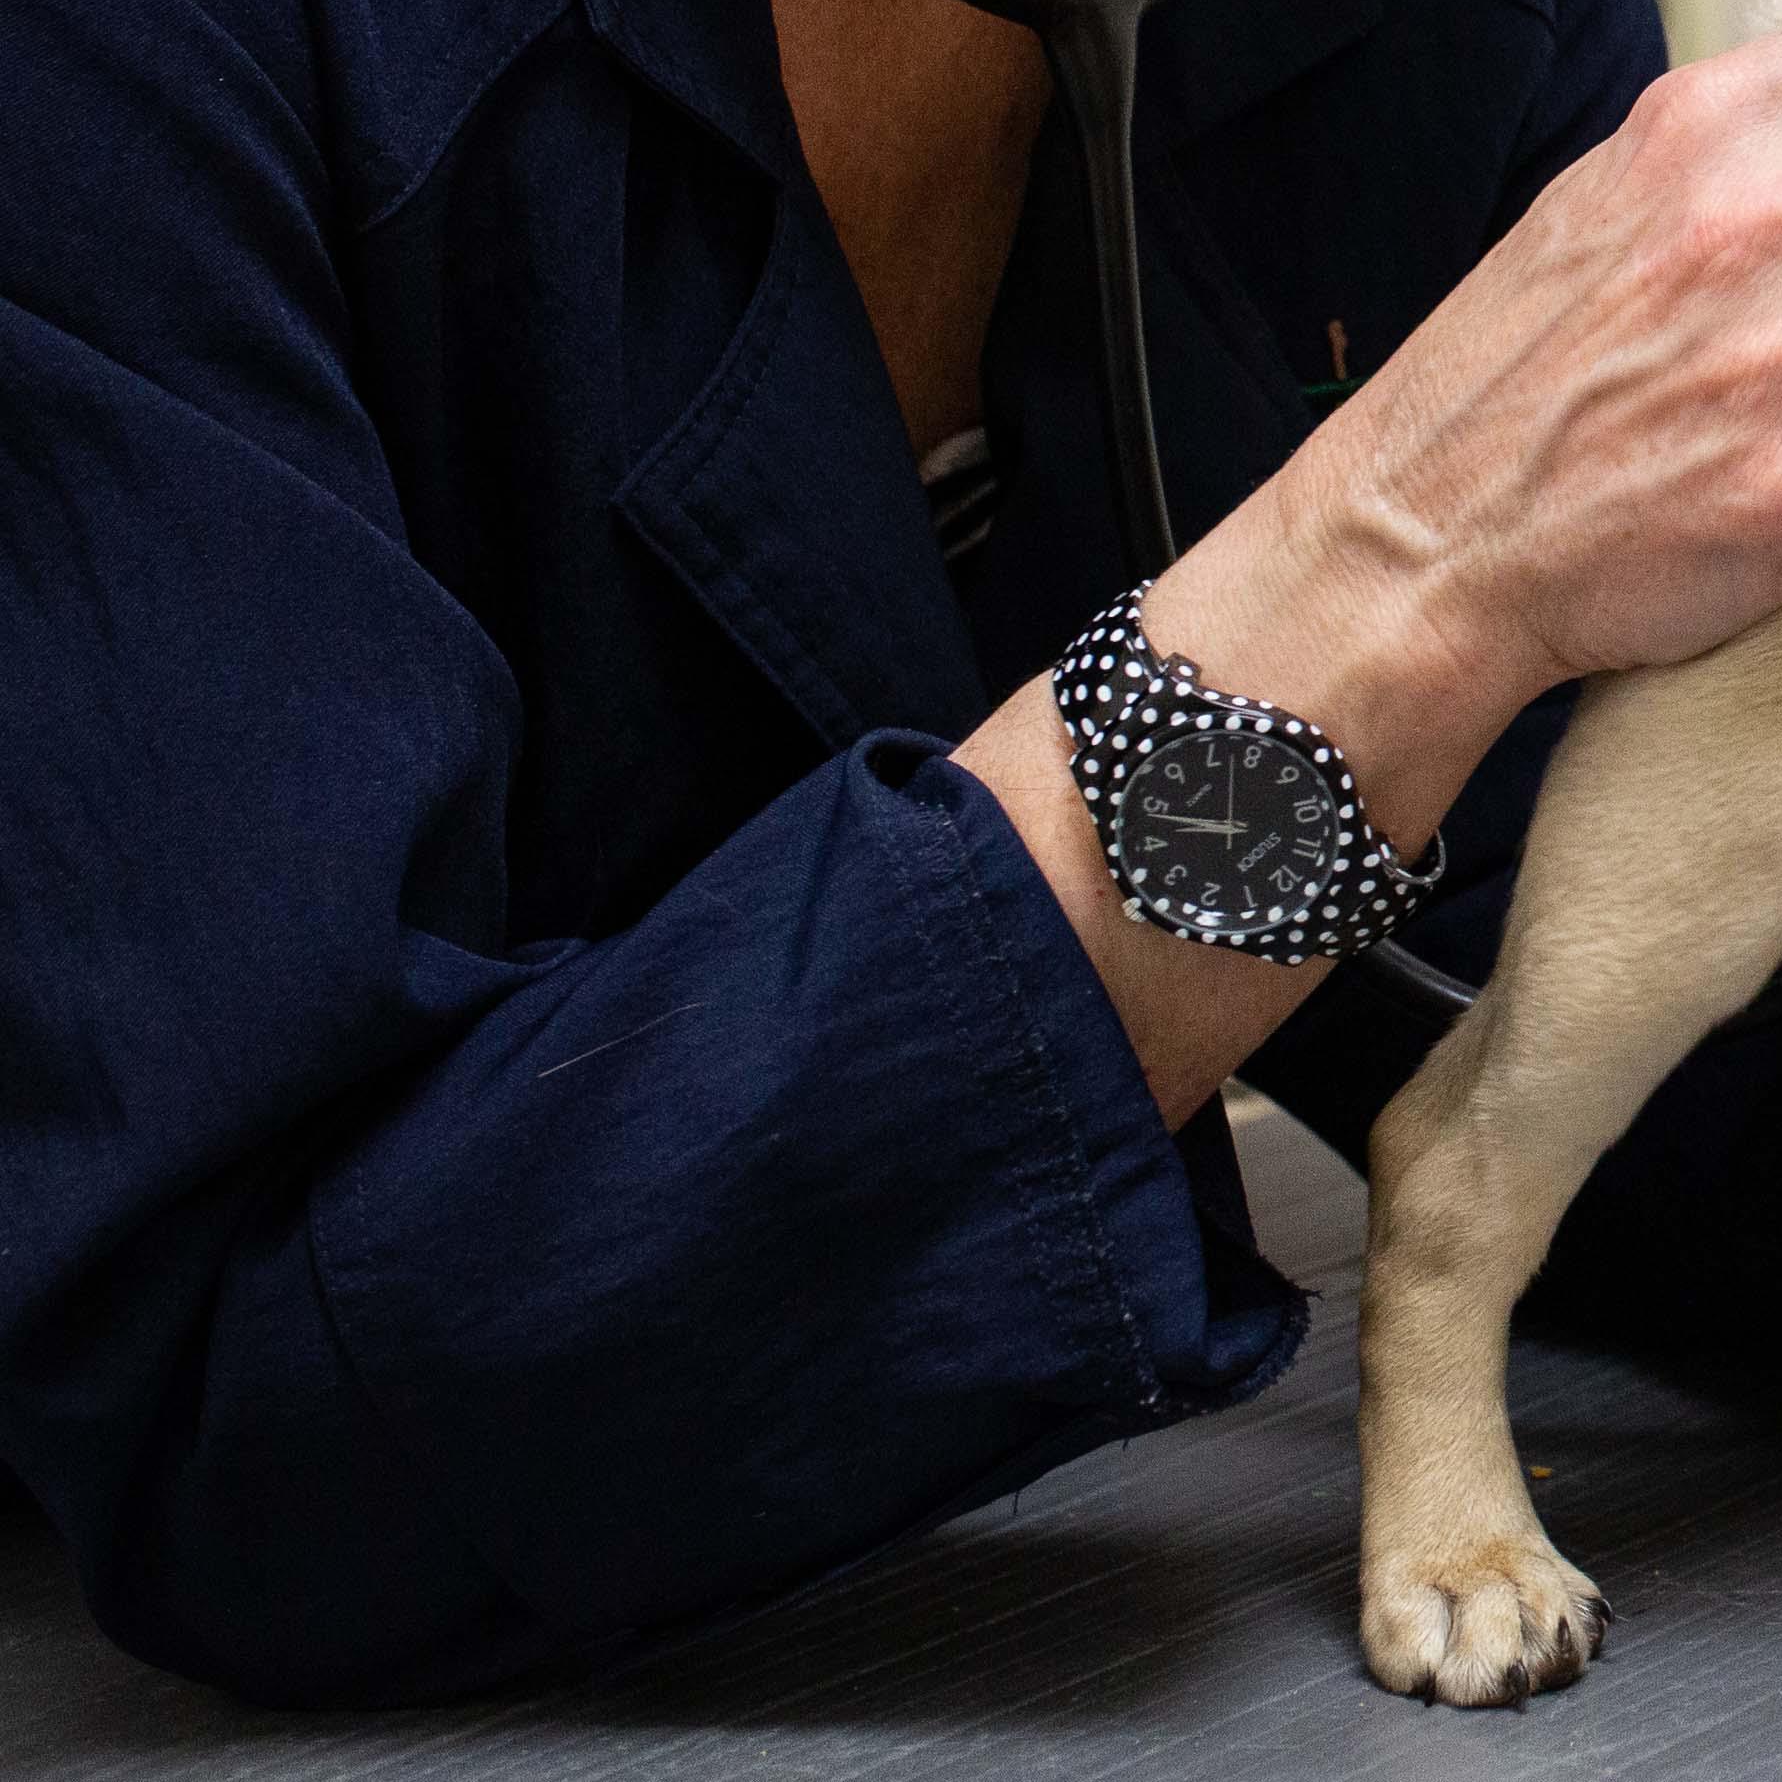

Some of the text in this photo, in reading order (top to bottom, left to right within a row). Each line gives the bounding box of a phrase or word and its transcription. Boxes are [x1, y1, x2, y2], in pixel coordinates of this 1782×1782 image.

[1206, 743, 1222, 768] 7
[1243, 745, 1262, 768] 8
[1164, 763, 1186, 784] 6
[1275, 766, 1300, 785] 9
[1143, 796, 1170, 814] 5
[1293, 795, 1322, 823] 10
[1143, 835, 1169, 852] 4
[1292, 838, 1322, 859] 11
[1164, 864, 1188, 887] 3
[1268, 865, 1303, 893] 12
[1200, 882, 1222, 907] 2
[1244, 885, 1258, 908] 1
